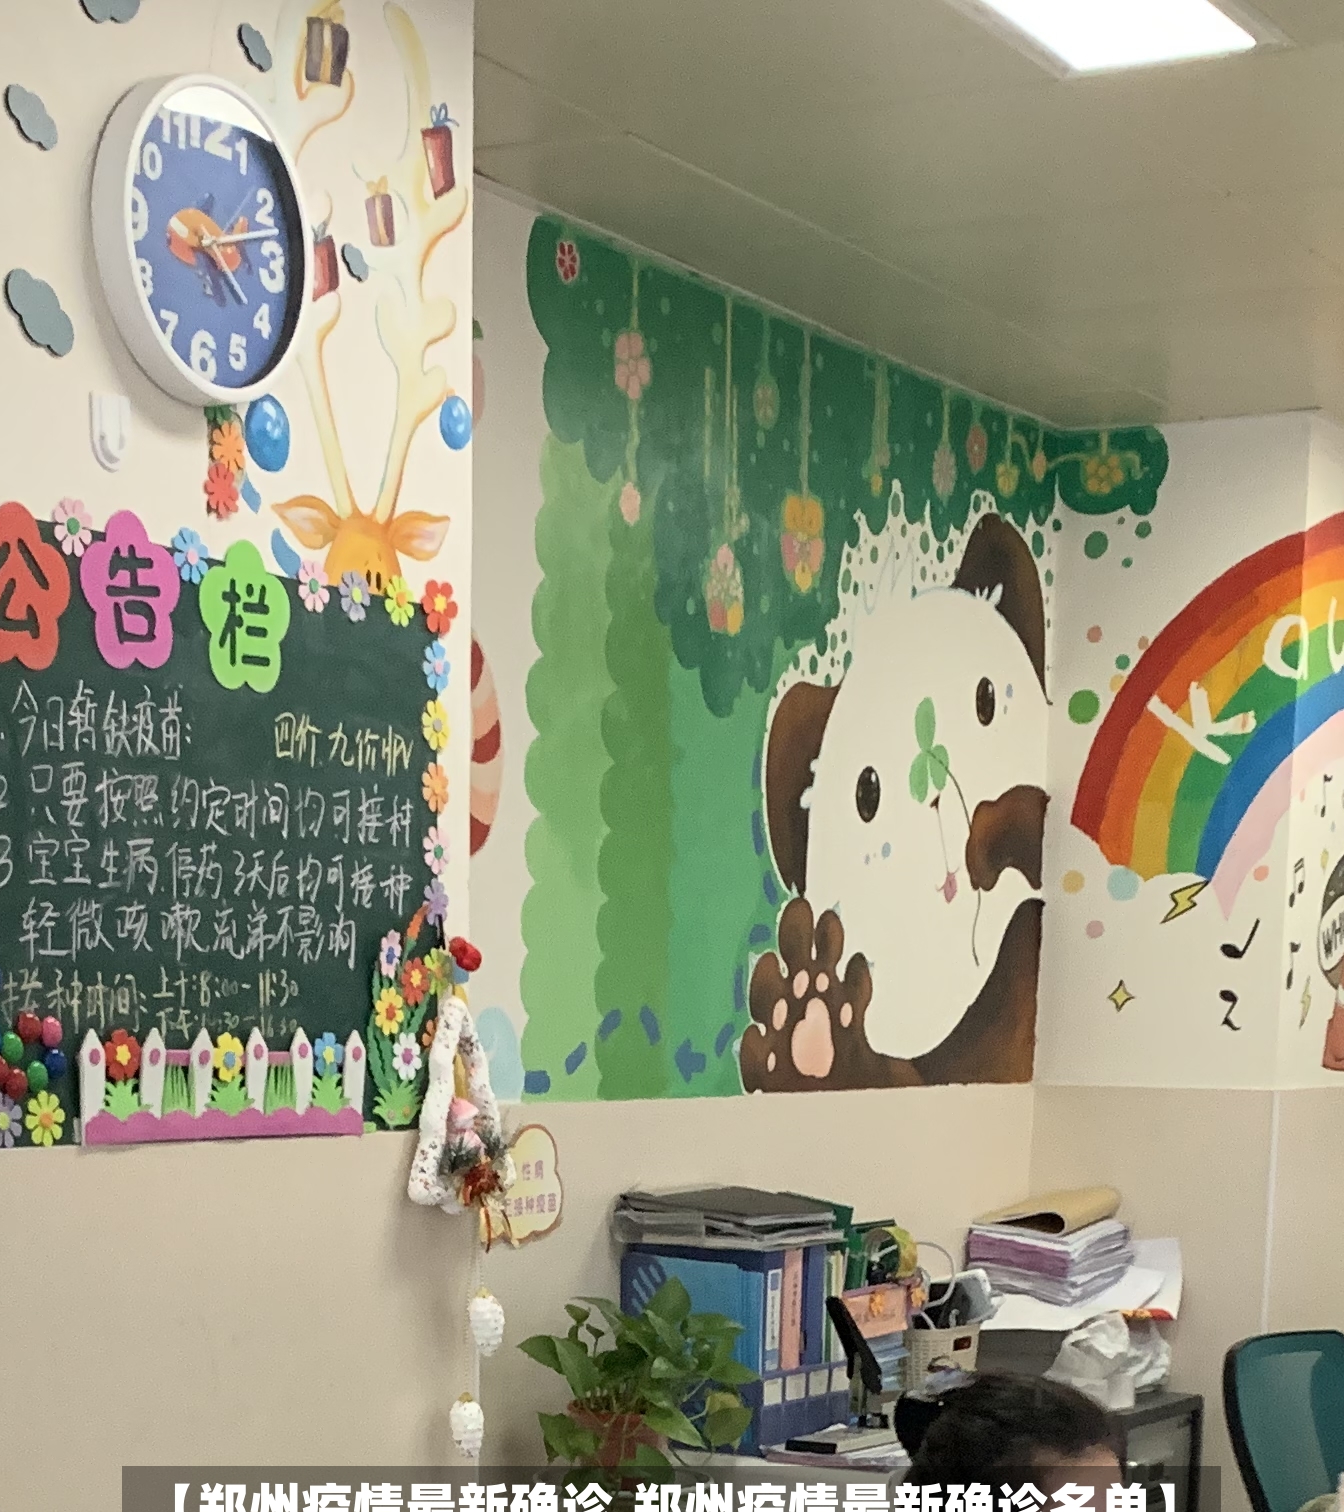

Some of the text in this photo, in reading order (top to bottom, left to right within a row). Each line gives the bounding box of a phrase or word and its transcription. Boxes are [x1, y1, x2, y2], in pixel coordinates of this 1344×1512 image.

[235, 137, 248, 176] 1
[255, 187, 274, 228] 2
[259, 240, 285, 293] 3
[253, 303, 272, 340] 4
[191, 329, 217, 383] 6
[229, 333, 247, 372] 5
